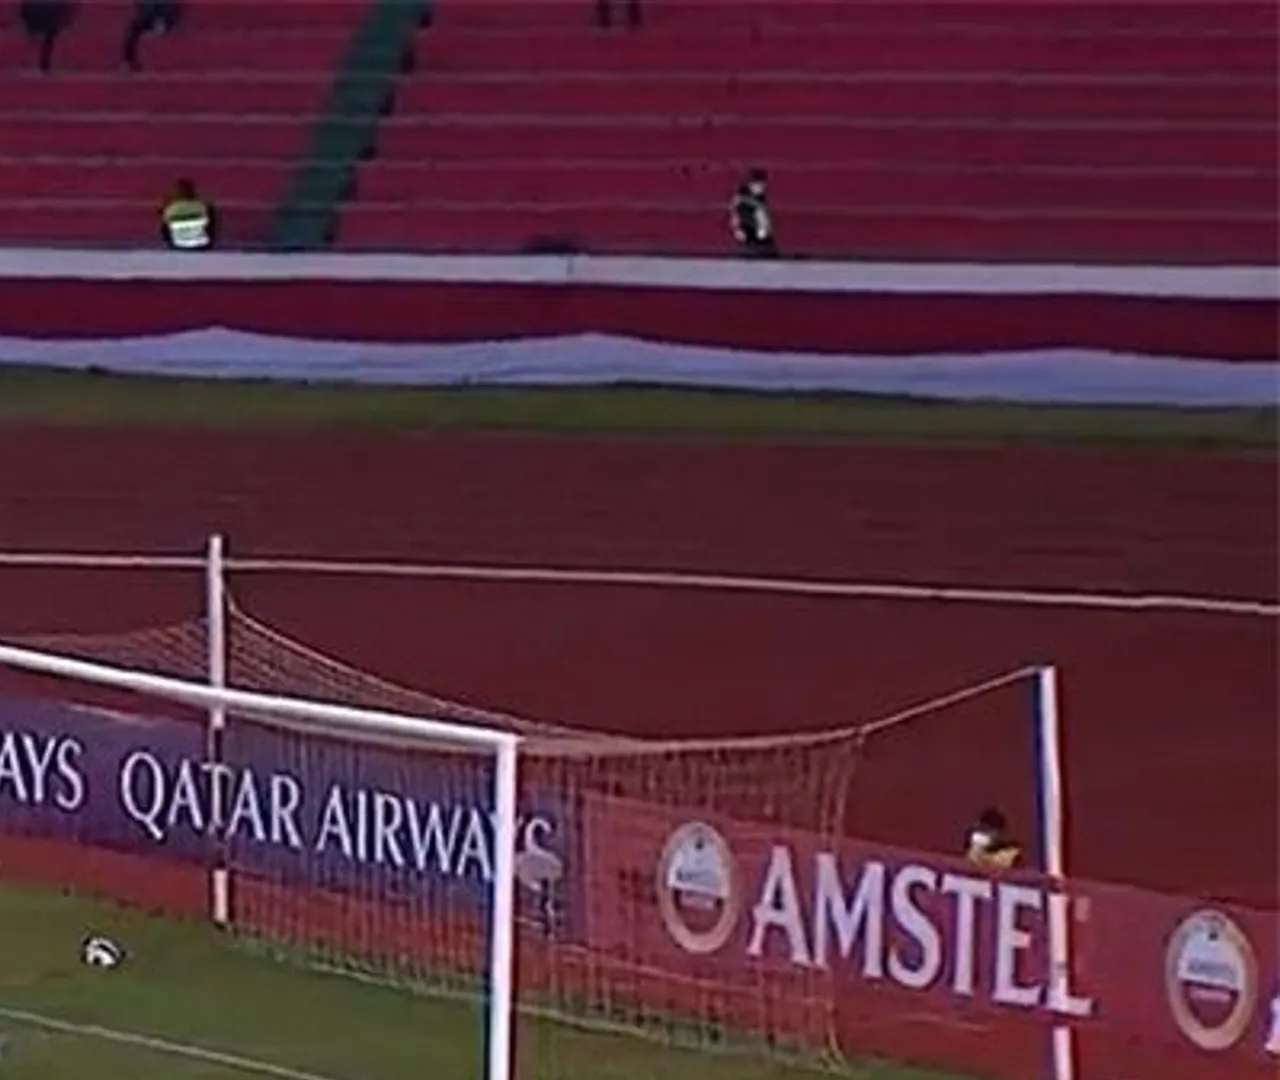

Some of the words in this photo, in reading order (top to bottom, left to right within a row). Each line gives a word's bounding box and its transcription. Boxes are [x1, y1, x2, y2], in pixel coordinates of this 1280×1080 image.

[120, 750, 303, 850] QATAR
[316, 784, 564, 892] AIRWAS
[745, 844, 1094, 1017] AMSTEL
